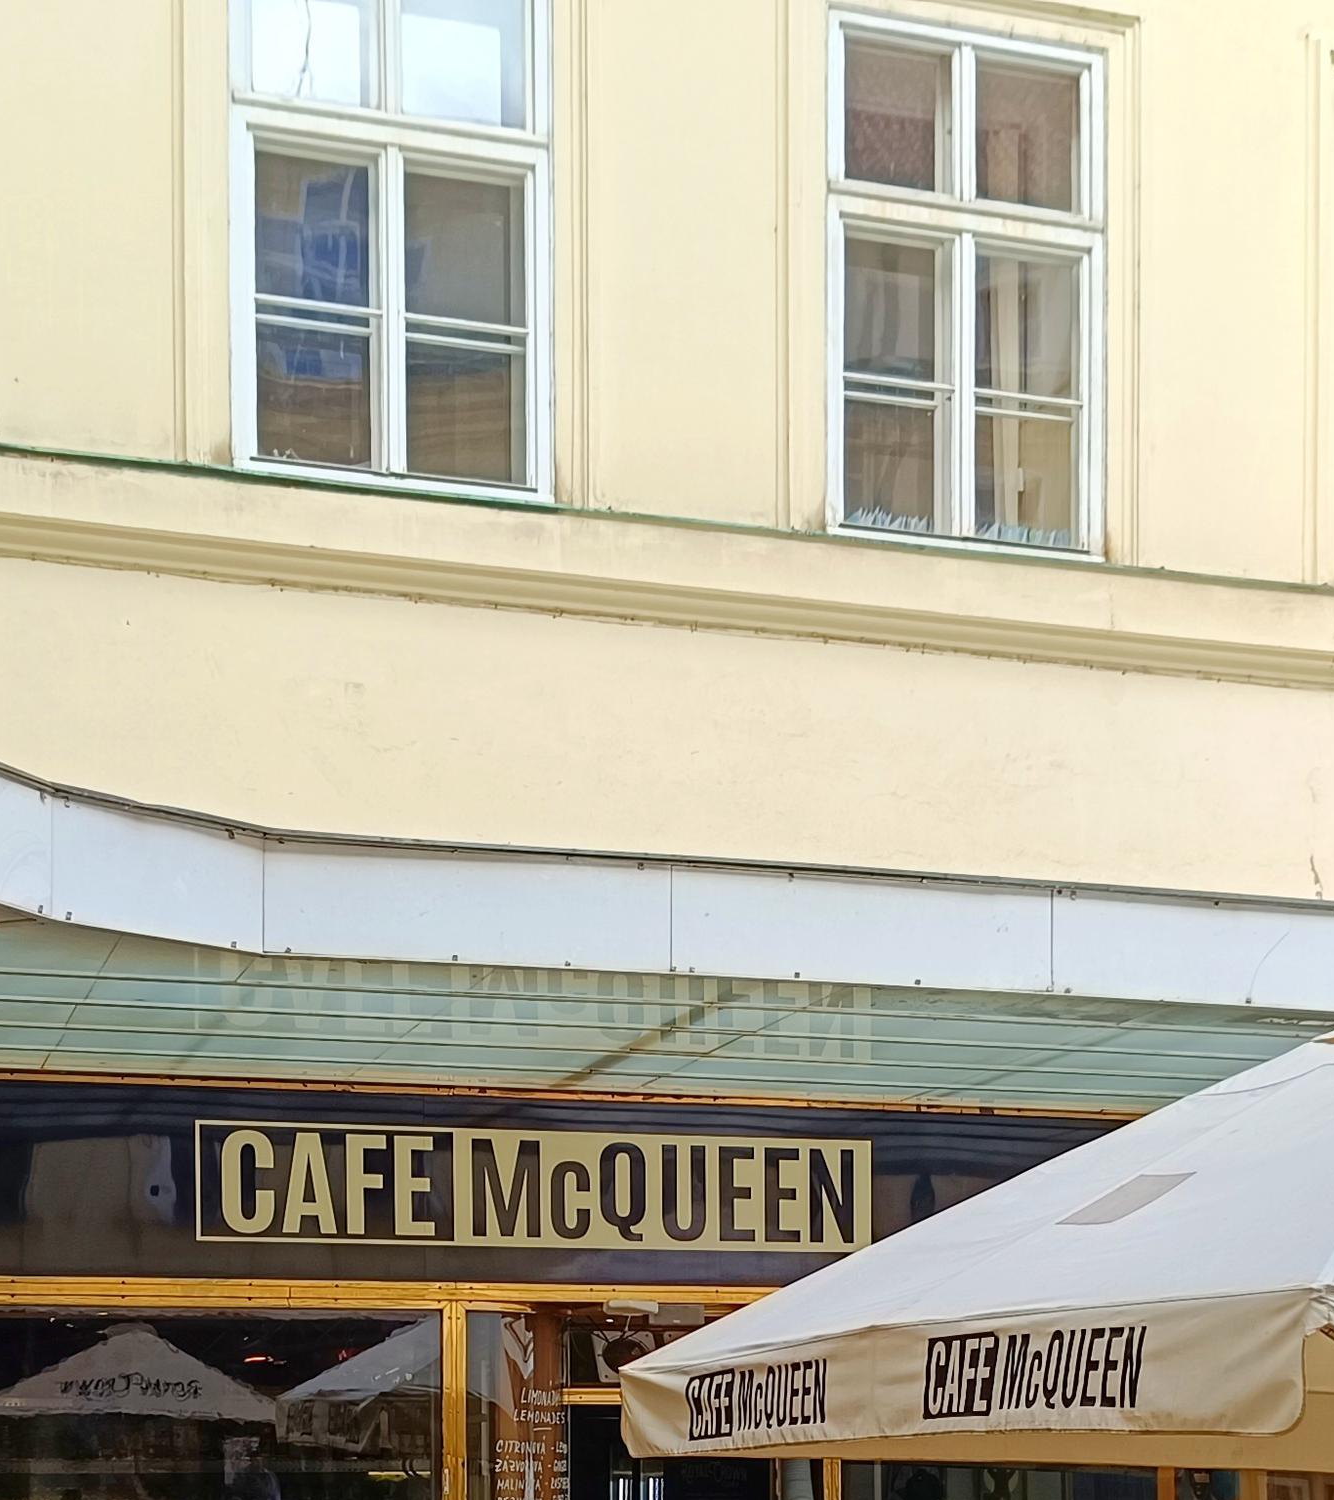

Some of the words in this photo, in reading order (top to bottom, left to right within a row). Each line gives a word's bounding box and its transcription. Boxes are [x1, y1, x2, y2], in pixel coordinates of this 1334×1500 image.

[220, 1129, 436, 1237] CAFE
[471, 1138, 855, 1244] McQUEEN
[688, 1371, 732, 1438] CAFE
[737, 1358, 828, 1431] McQUEEN
[927, 1335, 995, 1416] CAFE
[999, 1325, 1147, 1410] McQUEEN
[513, 1408, 565, 1425] LEMONADES
